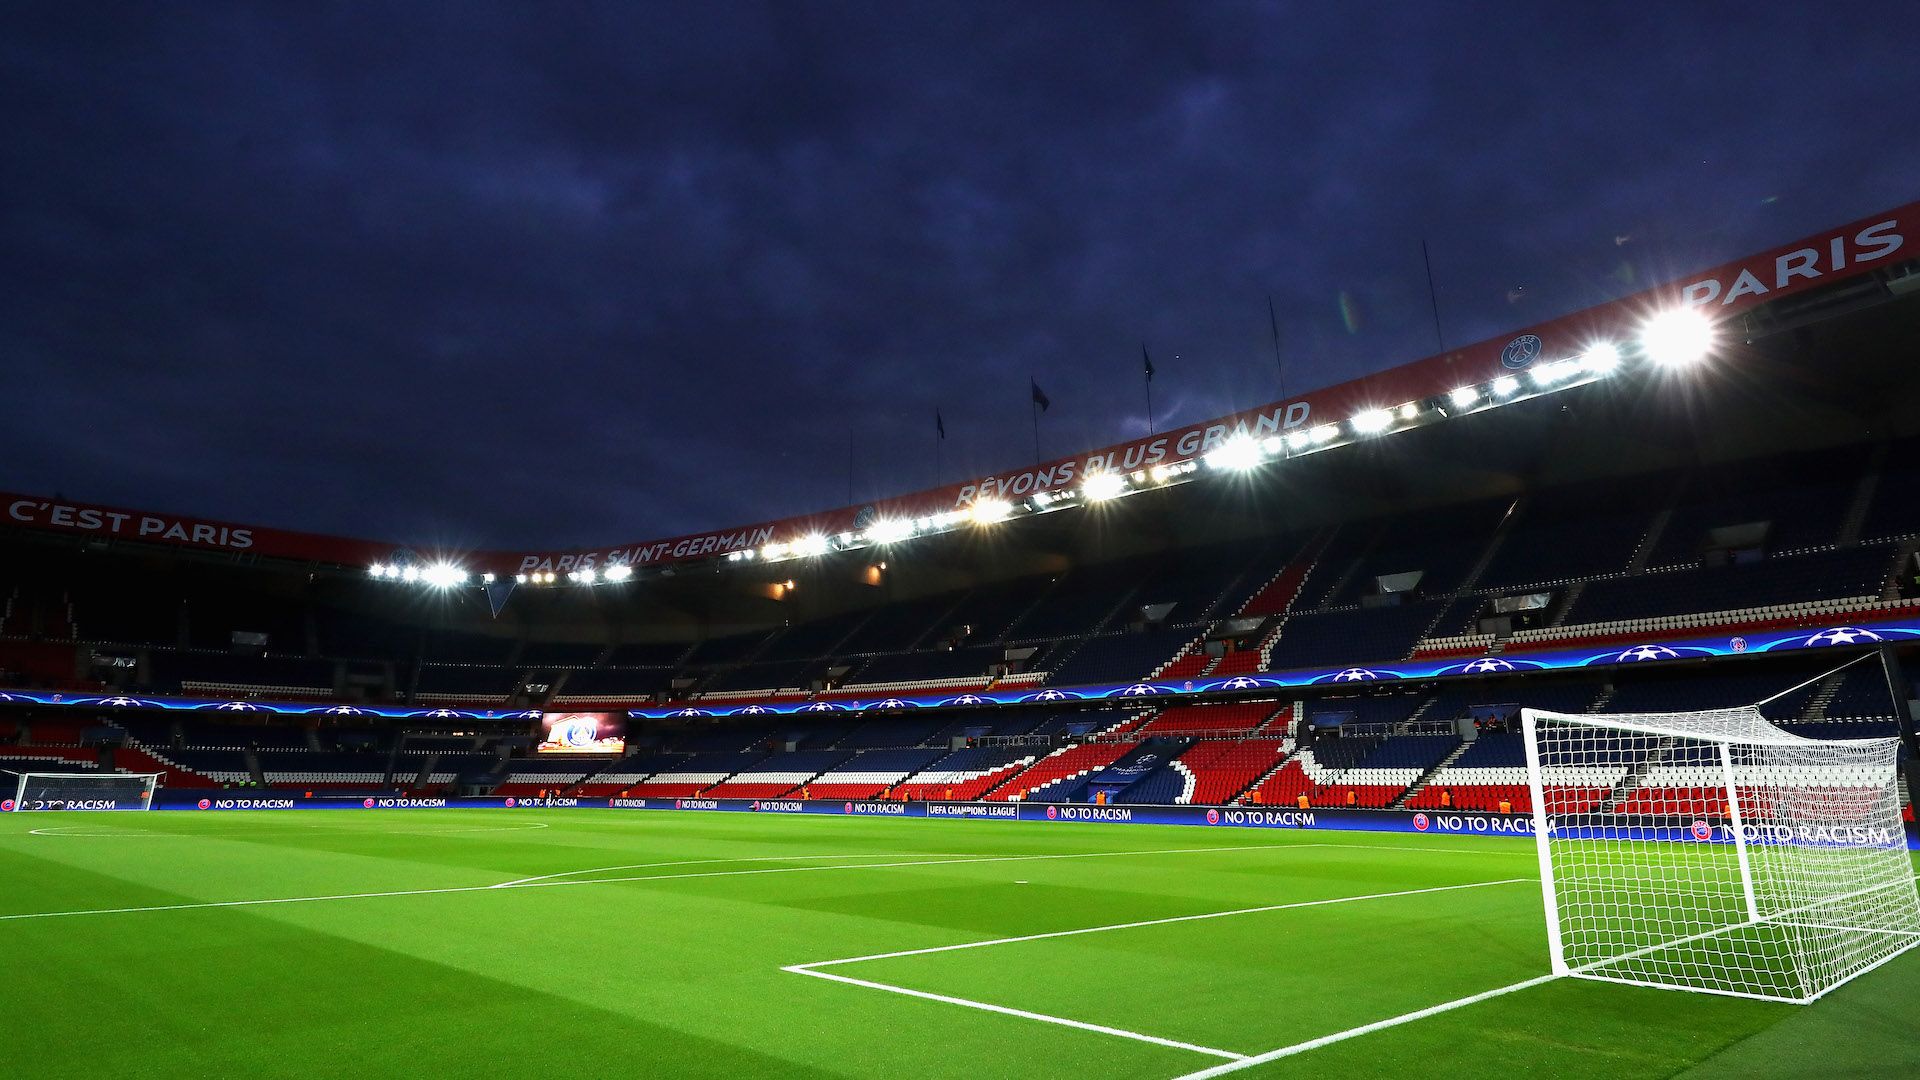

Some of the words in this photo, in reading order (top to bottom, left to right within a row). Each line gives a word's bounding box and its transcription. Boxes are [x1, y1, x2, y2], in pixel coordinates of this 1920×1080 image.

[1681, 219, 1904, 309] PARIS
[1509, 336, 1536, 348] PARIS
[1082, 438, 1168, 480] PLUS
[1176, 400, 1312, 456] GRAND
[9, 500, 131, 533] C'EST
[139, 516, 253, 549] PARIS
[519, 553, 598, 574] PARIS
[604, 526, 776, 568] SAINT-GERMAIN
[66, 800, 116, 810] RACISM
[215, 799, 234, 809] NO
[236, 799, 252, 809] TO
[253, 799, 294, 809] RACISM
[378, 799, 395, 807] NO
[396, 799, 410, 807] TO
[410, 799, 446, 807] RACISM
[518, 798, 532, 807] NO
[546, 798, 577, 807] RACISM
[615, 799, 622, 807] NO
[622, 799, 629, 807] TO
[629, 799, 645, 807] RACISM
[682, 800, 690, 809] NO
[690, 800, 698, 809] TO
[698, 800, 718, 809] RACISM
[761, 802, 772, 811] NO
[772, 802, 781, 811] TO
[781, 802, 802, 811] RACISM
[855, 803, 866, 812] NO
[867, 803, 877, 813] TO
[877, 803, 905, 814] RACISM
[930, 805, 946, 814] UEFA
[948, 805, 987, 816] CHAMPIONS
[989, 807, 1016, 817] LEAGUE
[1061, 808, 1076, 819] NO
[1078, 808, 1091, 819] TO
[1093, 809, 1131, 821] RACISM
[1225, 811, 1245, 824] NO
[1246, 812, 1263, 824] TO
[1266, 812, 1315, 826] RACISM
[1437, 816, 1462, 830] NO
[1464, 817, 1487, 831] TO
[1723, 824, 1758, 840] NO
[1763, 825, 1793, 841] TO
[1799, 826, 1891, 845] RACISM
